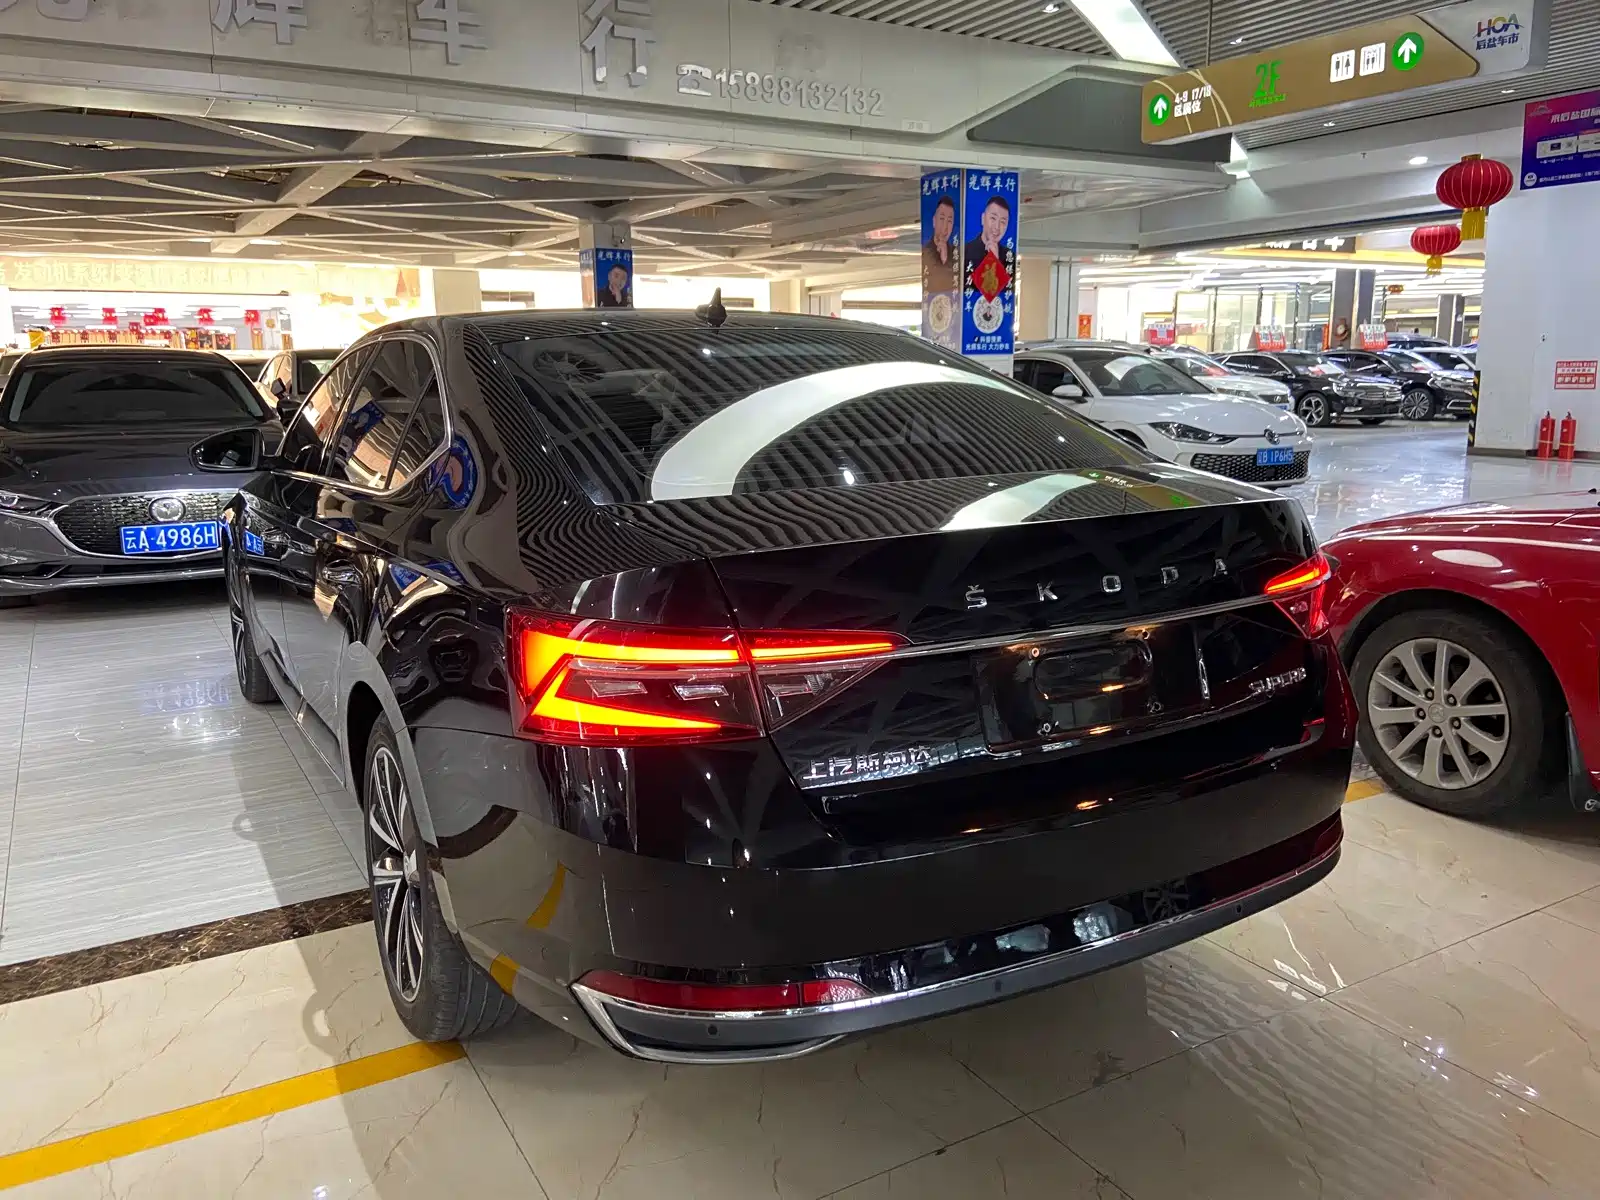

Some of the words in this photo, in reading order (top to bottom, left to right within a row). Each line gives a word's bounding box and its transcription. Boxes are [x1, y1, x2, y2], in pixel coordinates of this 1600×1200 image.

[714, 68, 886, 117] 15898132132
[1191, 84, 1211, 100] 17/18
[1253, 59, 1285, 98] 2F
[969, 174, 1016, 193] 光辉车行
[965, 558, 1228, 610] ŠKODA
[1249, 667, 1307, 692] SUPERB
